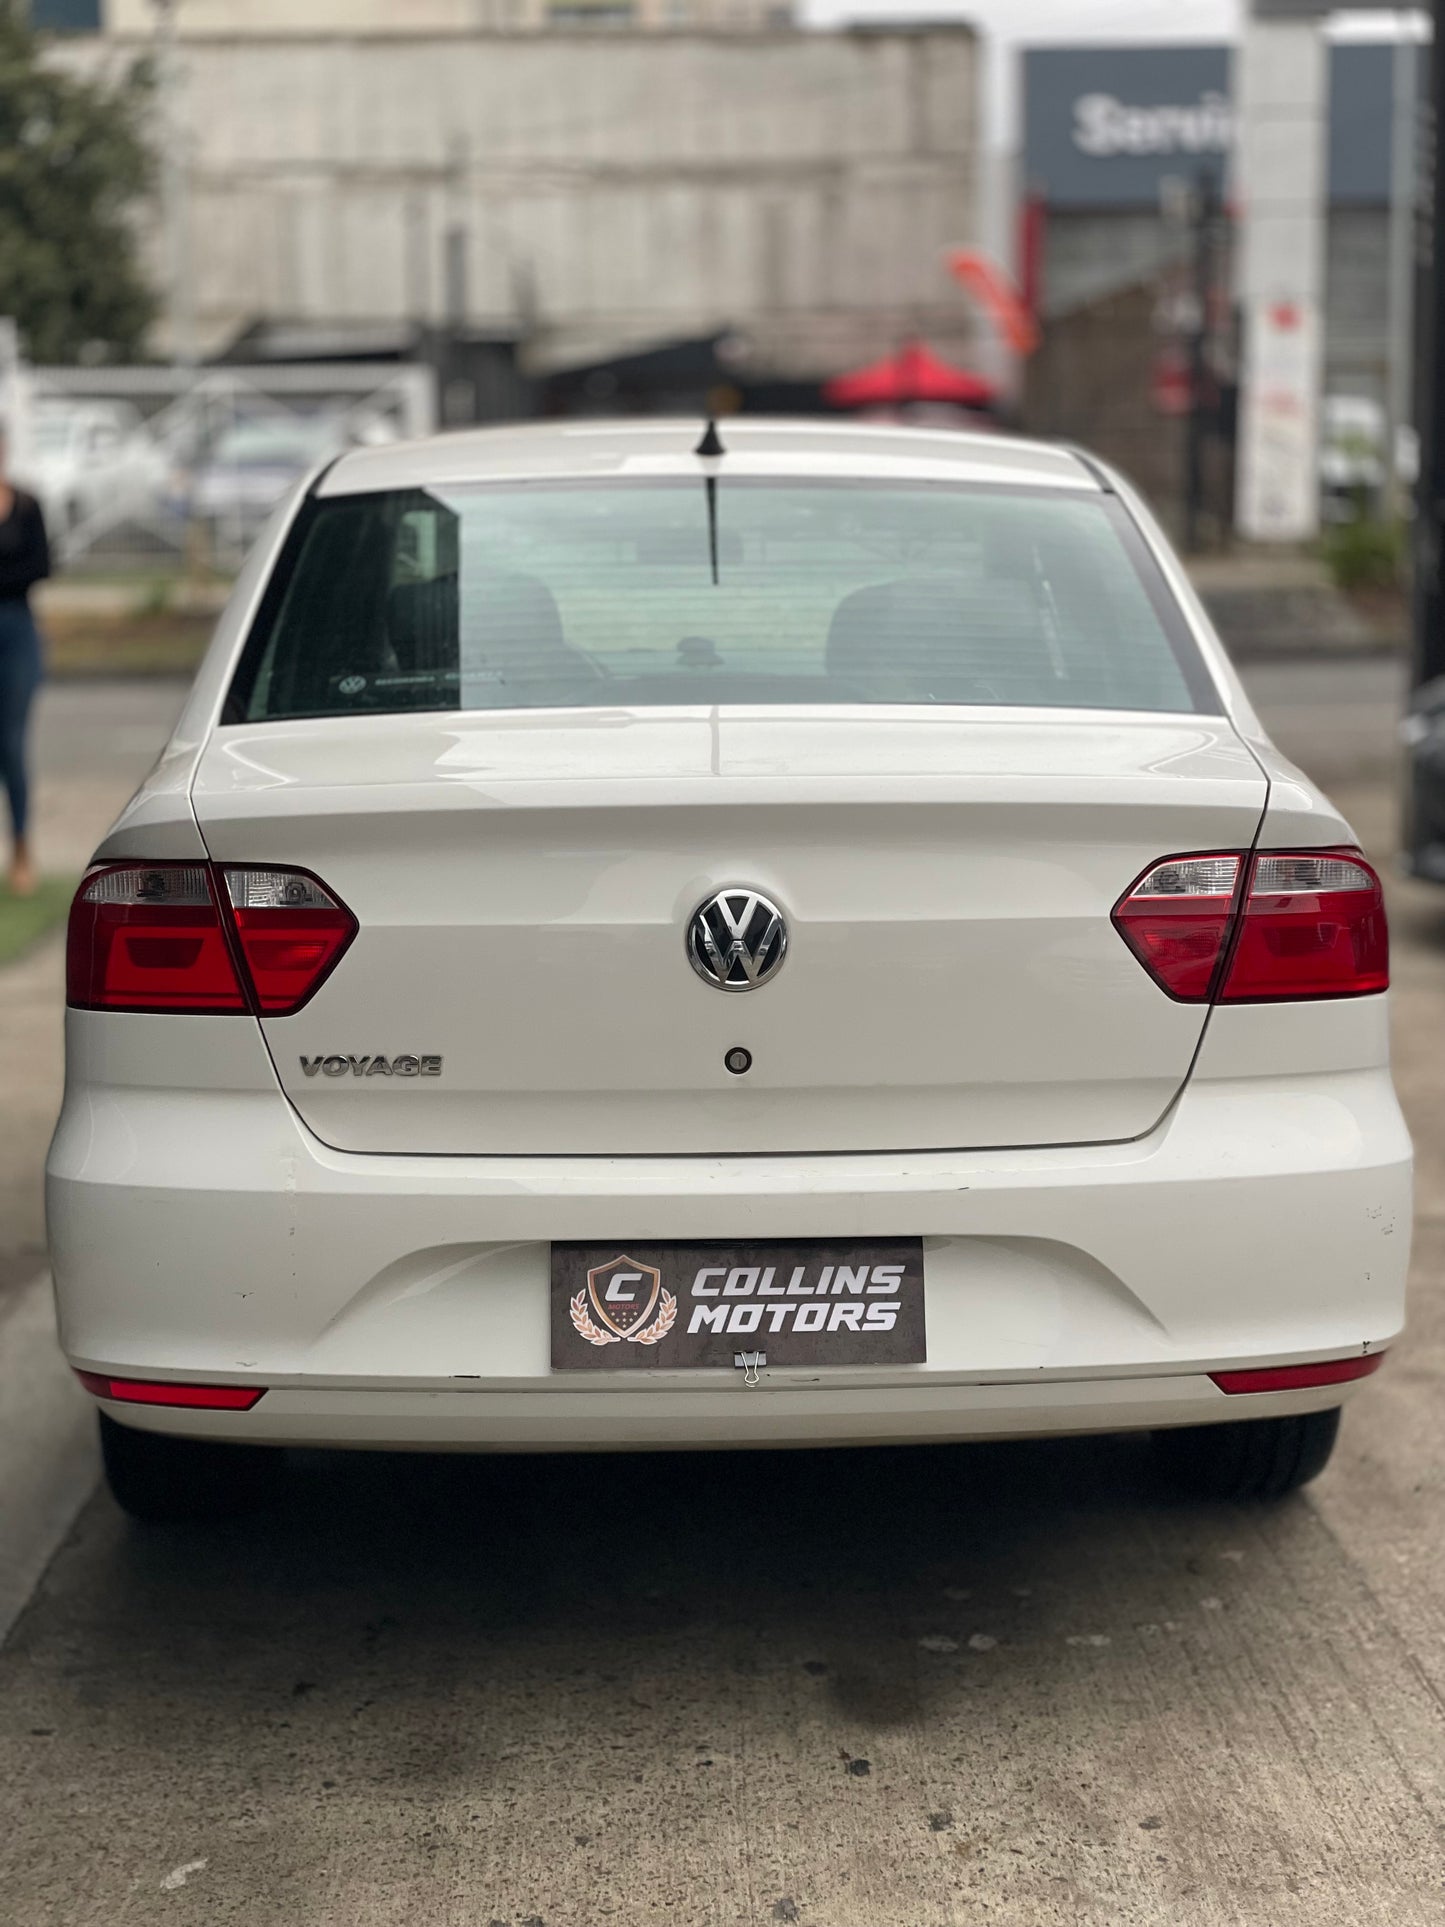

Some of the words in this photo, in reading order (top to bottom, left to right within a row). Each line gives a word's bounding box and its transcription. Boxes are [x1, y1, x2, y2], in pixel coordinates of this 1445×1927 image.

[299, 1055, 444, 1077] VOYAGE
[605, 1273, 643, 1302] C
[690, 1265, 906, 1297] COLLINS
[608, 1303, 640, 1311] MOTORS
[686, 1302, 902, 1334] MOTORS
